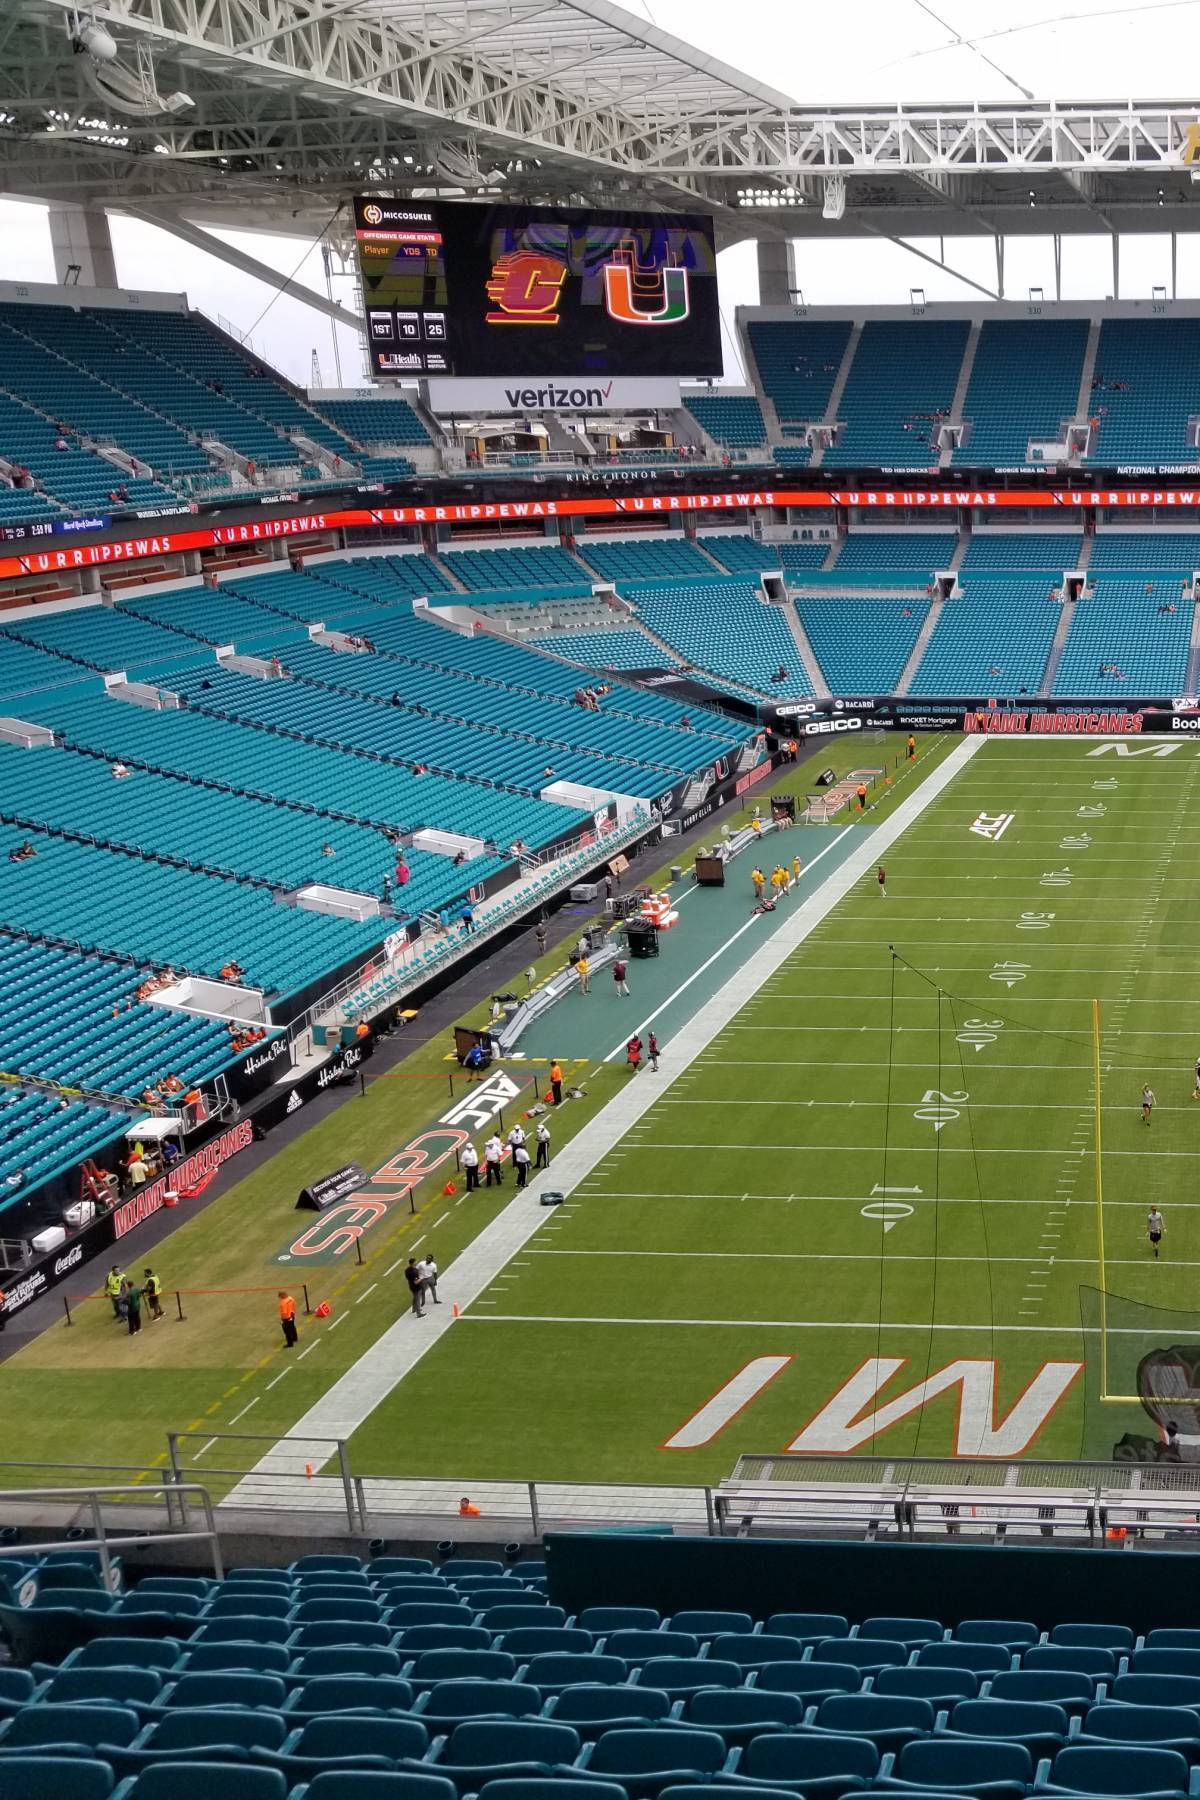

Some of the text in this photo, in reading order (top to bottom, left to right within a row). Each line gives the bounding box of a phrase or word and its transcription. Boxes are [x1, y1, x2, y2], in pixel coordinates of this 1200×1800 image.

[383, 211, 432, 221] MICCOSUKEE
[364, 245, 389, 255] Player
[426, 248, 437, 256] TD
[374, 324, 390, 334] 1ST
[402, 324, 415, 335] 10
[505, 383, 603, 408] verizon
[566, 470, 658, 482] RING HONOR
[1117, 466, 1157, 475] NATIONAL
[775, 703, 816, 716] GEICO
[805, 718, 861, 735] GEICO
[928, 717, 957, 726] Mortgage
[964, 712, 1144, 734] MIAMI HURRICANES
[968, 811, 1009, 839] ACC
[1015, 912, 1056, 930] 50
[988, 960, 1032, 981] 40
[955, 1018, 1005, 1043] 30
[464, 1074, 522, 1130] ACC
[913, 1089, 970, 1120] 20
[114, 1118, 253, 1240] MIAMI HURRICANES
[860, 1183, 923, 1219] 10
